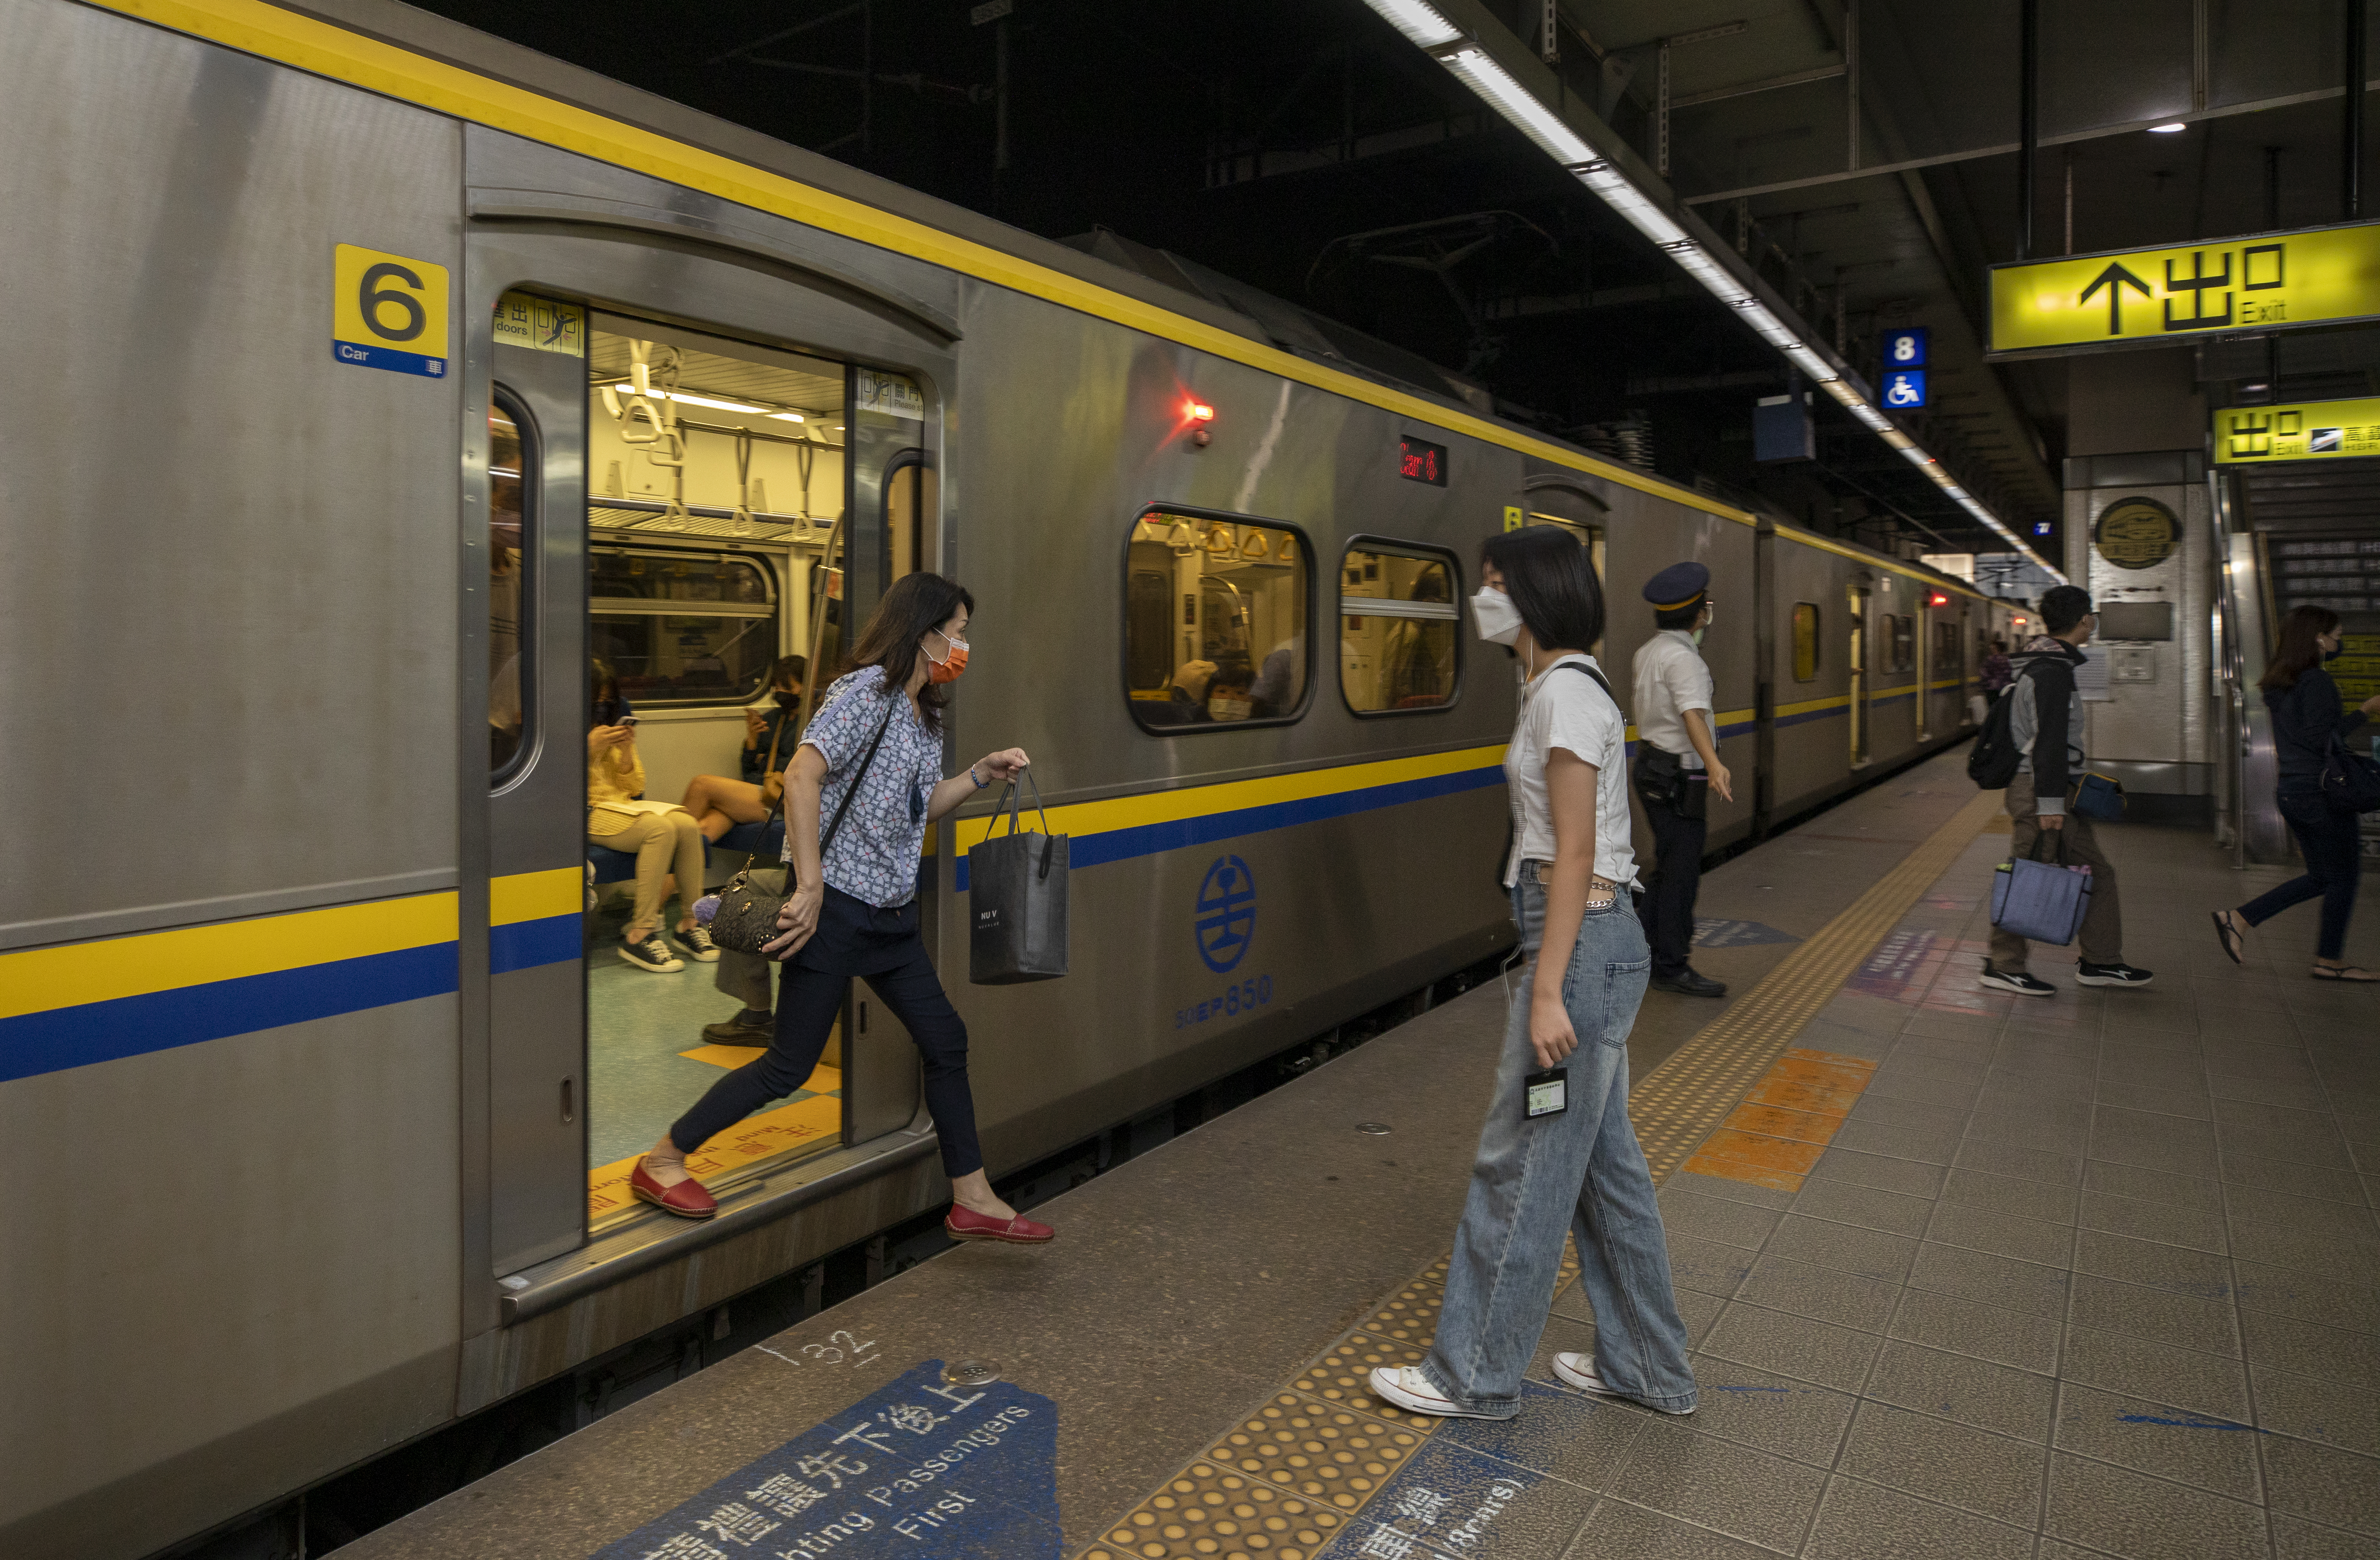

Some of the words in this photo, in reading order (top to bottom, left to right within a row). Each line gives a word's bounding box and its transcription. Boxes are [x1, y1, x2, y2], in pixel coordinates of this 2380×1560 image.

[2164, 243, 2286, 331] 出口
[359, 263, 426, 341] 6
[2241, 298, 2286, 323] Exit
[496, 321, 528, 335] doors
[341, 345, 369, 361] Car
[1894, 336, 1915, 361] 8
[426, 360, 442, 375] 車
[895, 399, 916, 410] Please
[2229, 410, 2303, 458] 出口
[865, 1406, 1030, 1507] Passengers
[891, 1489, 976, 1540] First
